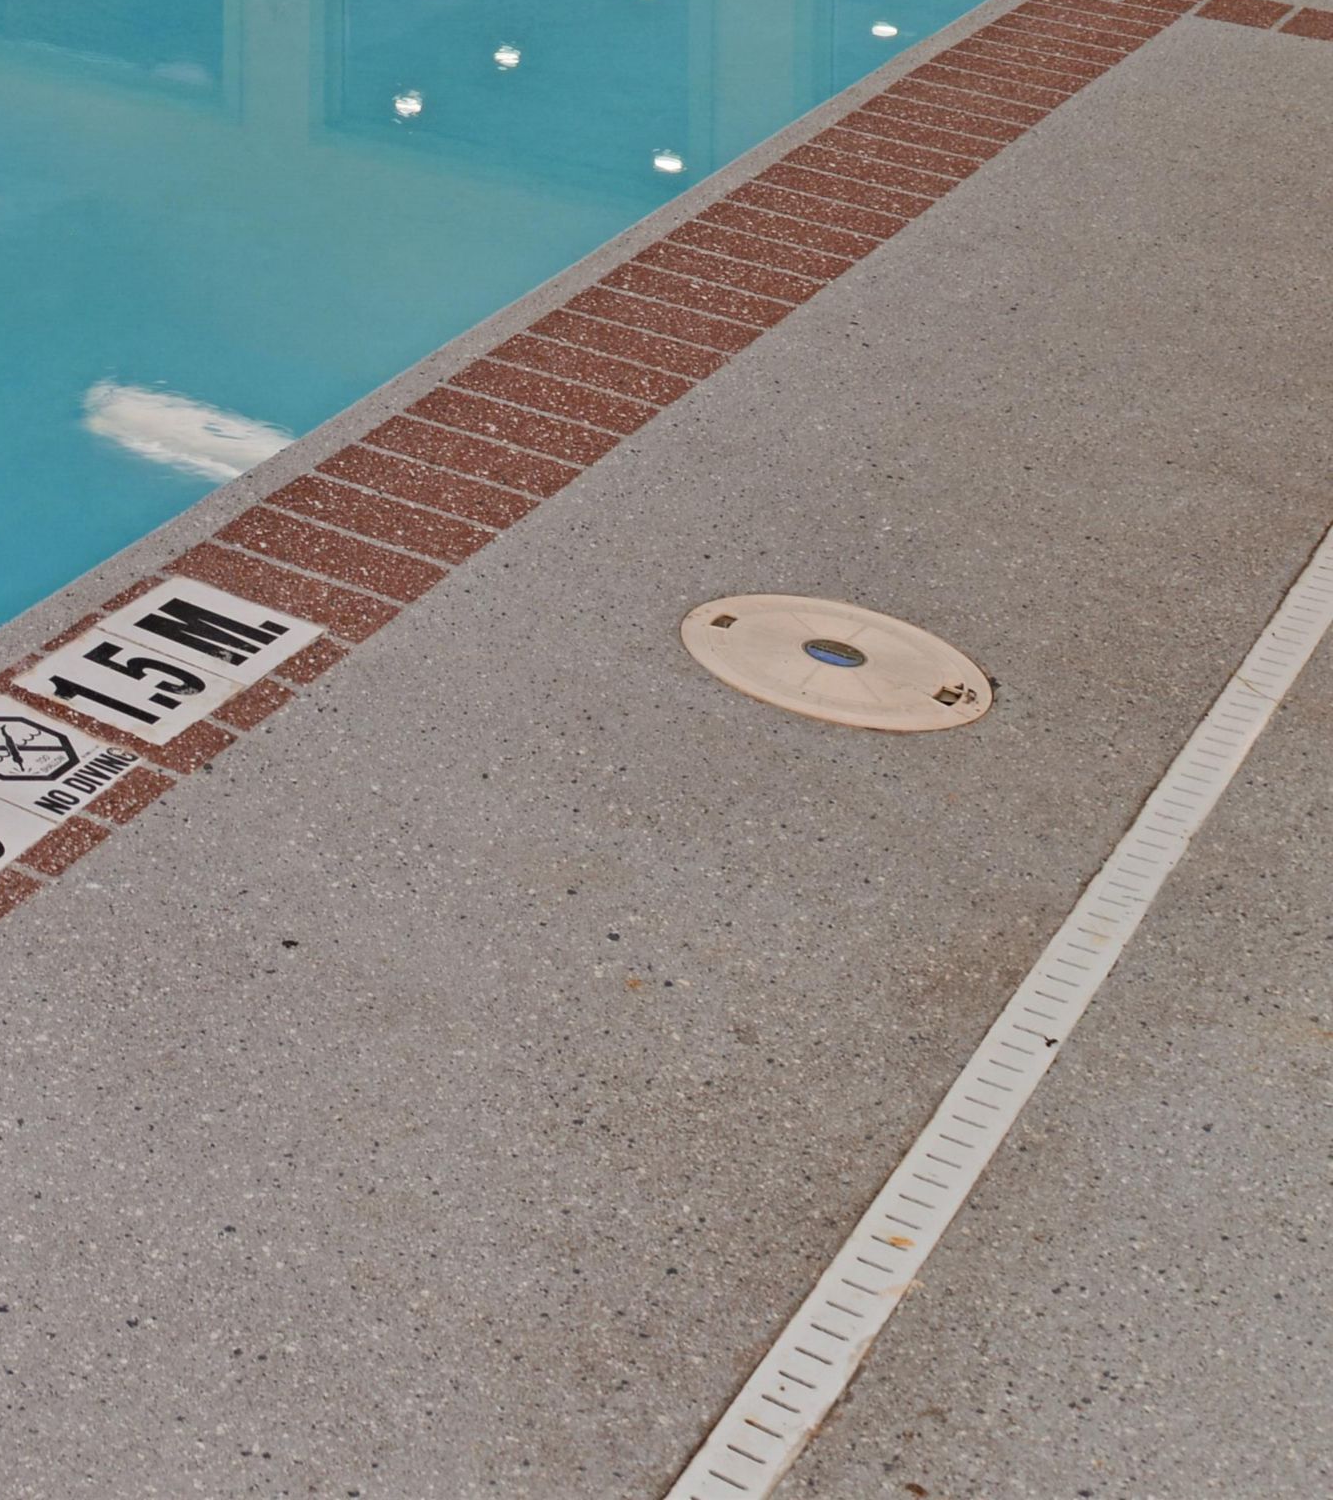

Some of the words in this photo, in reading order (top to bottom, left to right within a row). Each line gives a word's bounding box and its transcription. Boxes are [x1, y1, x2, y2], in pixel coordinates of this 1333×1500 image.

[49, 641, 206, 725] 1.5
[134, 597, 290, 667] M.
[34, 789, 81, 816] NO
[62, 746, 141, 795] DIVING
